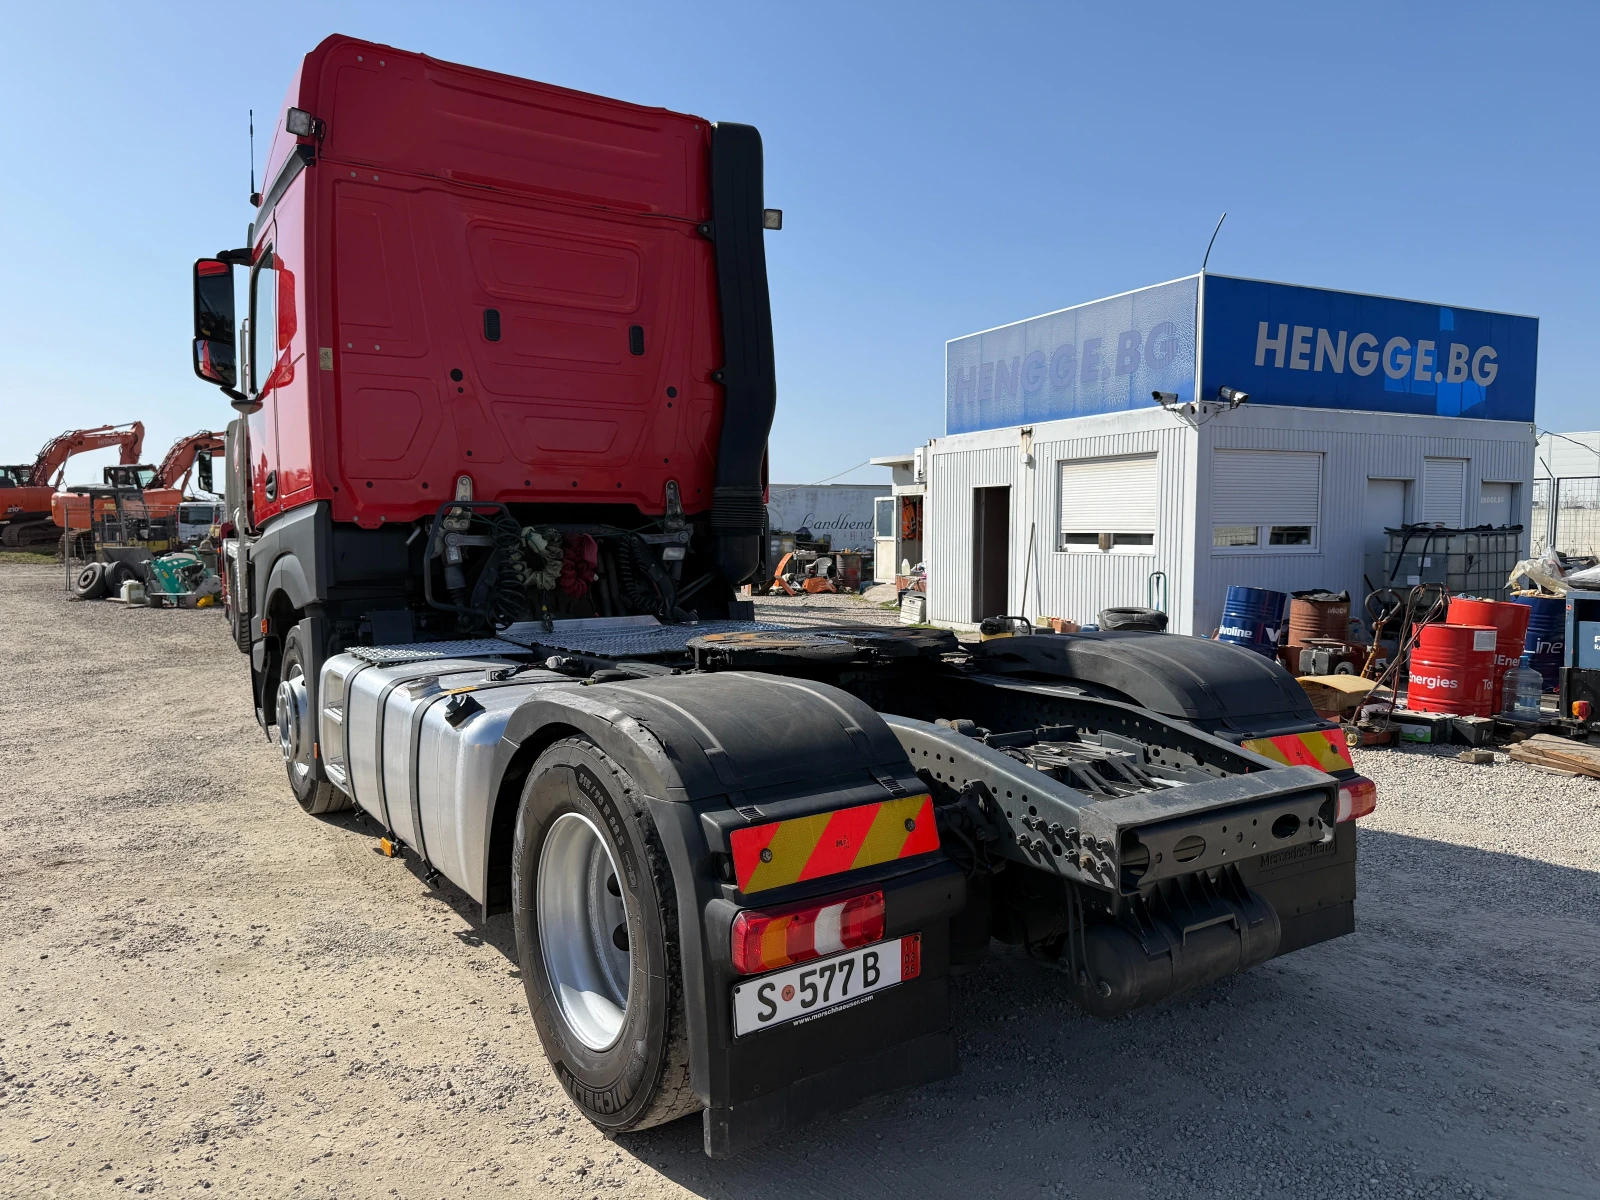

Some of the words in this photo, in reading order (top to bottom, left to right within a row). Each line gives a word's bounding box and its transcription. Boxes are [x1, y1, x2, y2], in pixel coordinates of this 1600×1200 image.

[955, 321, 1179, 403] HENGGE.BG
[1254, 321, 1499, 387] HENGGE.BG
[801, 512, 874, 530] Landhend
[904, 952, 915, 964] 03
[905, 939, 915, 952] 11
[904, 964, 915, 977] 26
[757, 982, 778, 1023] S
[800, 958, 855, 1009] 577
[862, 951, 881, 989] B
[561, 1068, 634, 1114] MICHELIN
